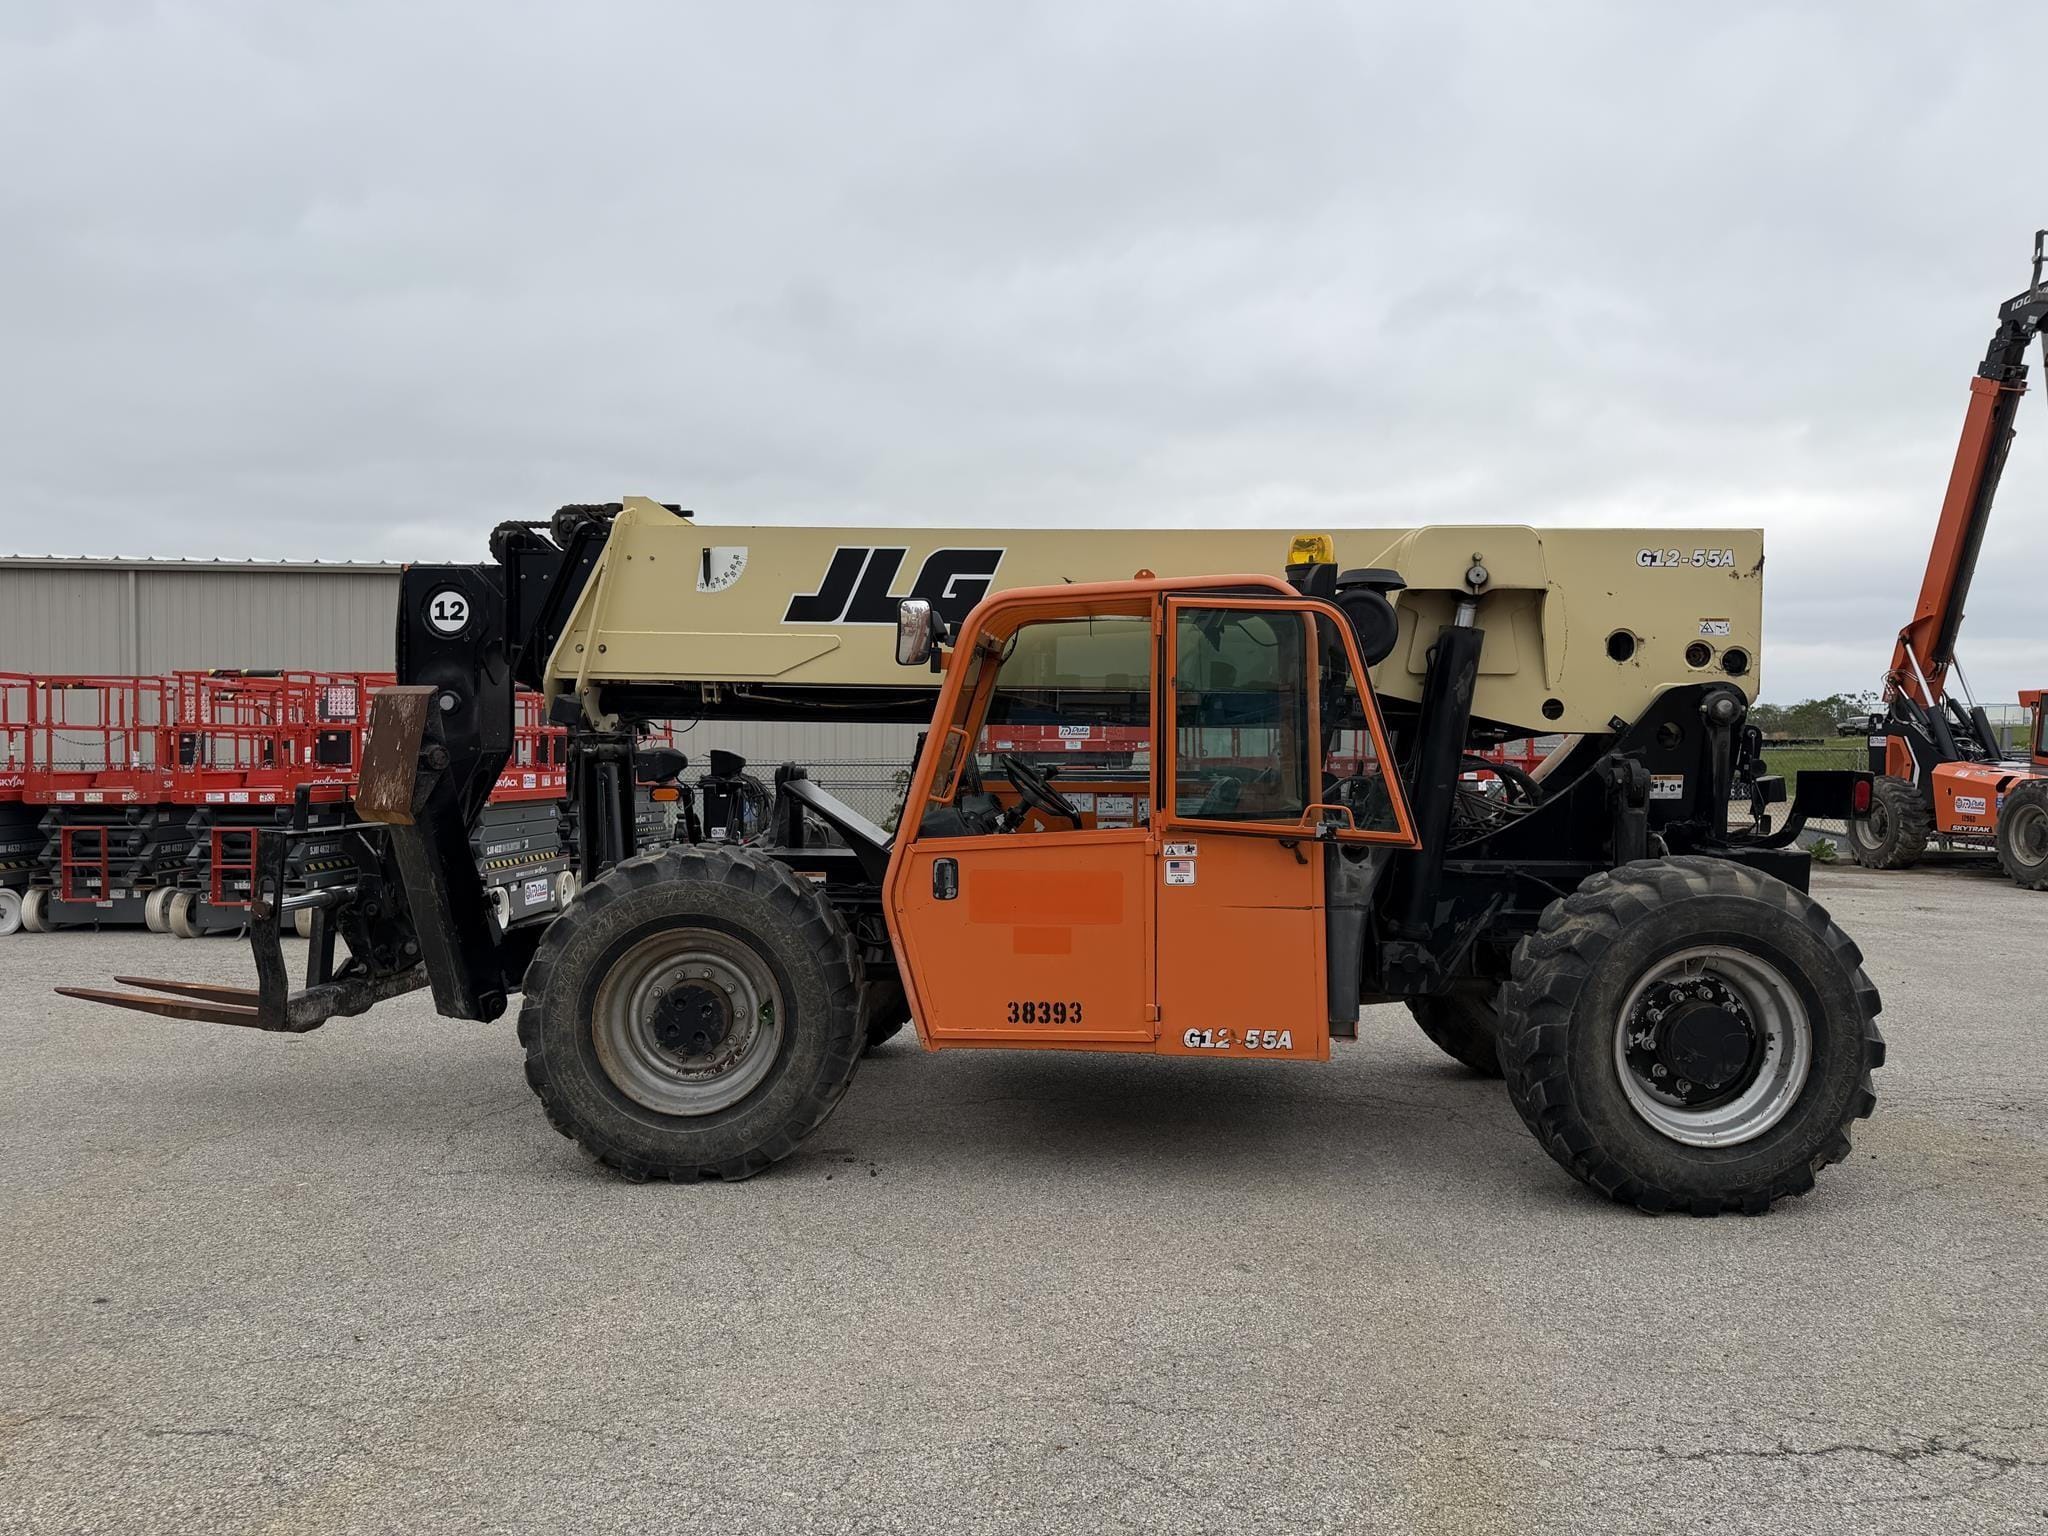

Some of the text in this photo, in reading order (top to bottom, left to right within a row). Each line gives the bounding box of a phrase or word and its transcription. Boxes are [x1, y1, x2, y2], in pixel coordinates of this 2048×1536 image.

[1636, 548, 1735, 568] G12-55A
[780, 546, 1007, 626] JLG
[434, 600, 465, 621] 12
[1952, 825, 1990, 833] SKYTRAK
[1007, 1001, 1082, 1024] 38393
